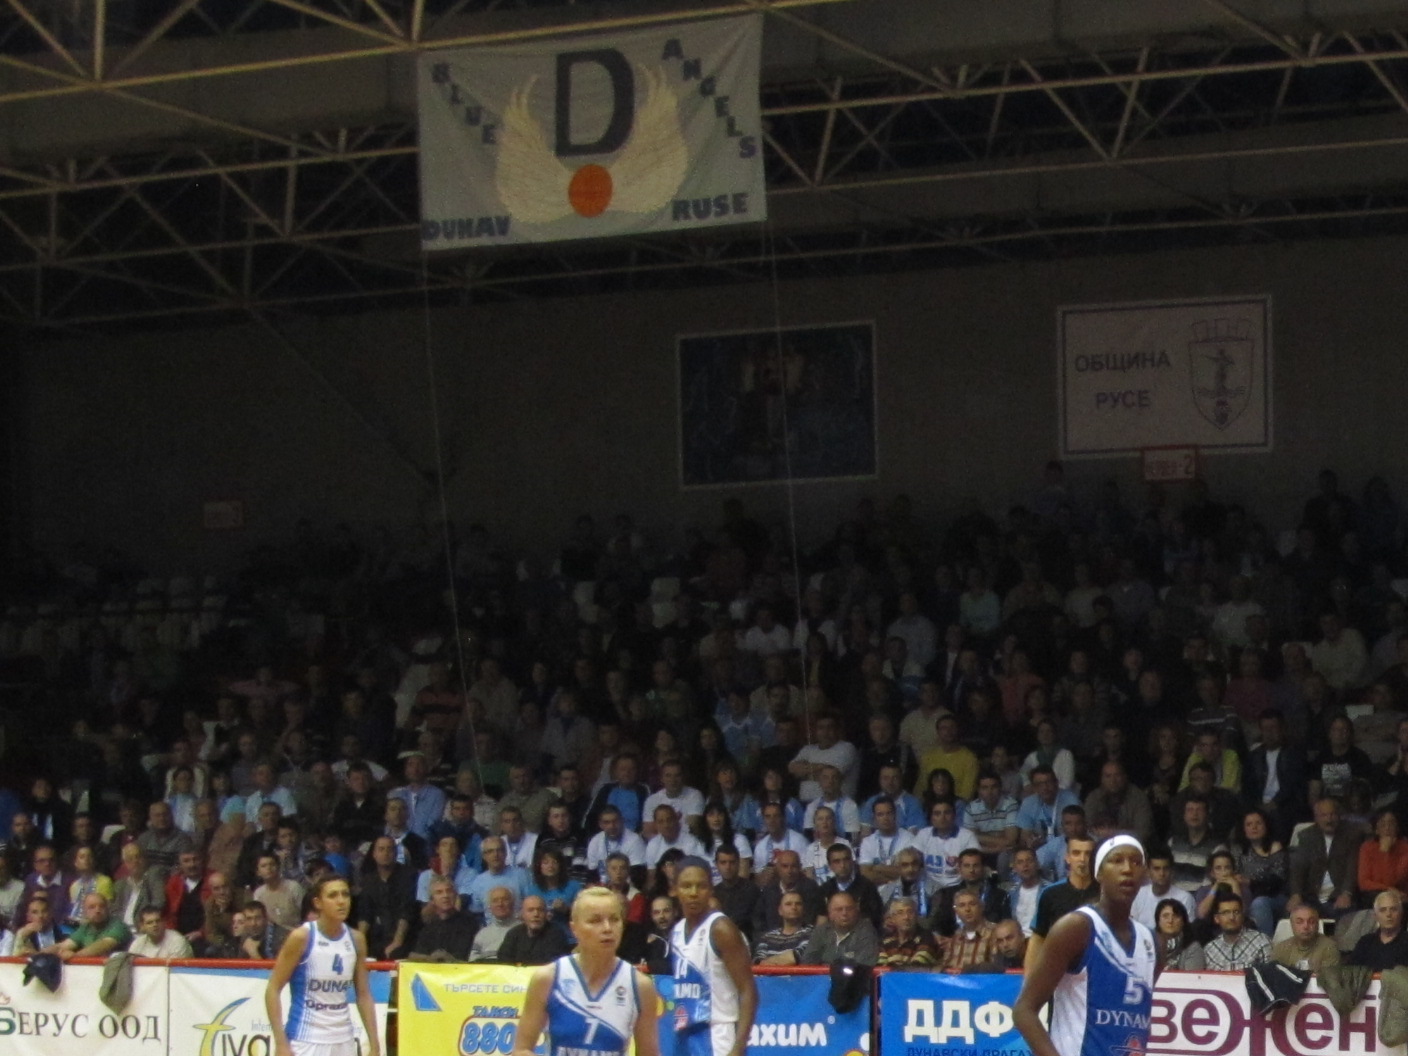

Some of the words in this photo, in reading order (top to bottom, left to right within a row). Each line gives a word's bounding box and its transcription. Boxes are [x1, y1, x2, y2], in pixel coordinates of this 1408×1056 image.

[556, 47, 635, 157] D
[662, 38, 757, 158] ANGELS
[672, 193, 750, 221] RUSE
[421, 215, 512, 241] DUNAV
[1074, 351, 1171, 373] ОБЩИНА
[1096, 390, 1150, 409] РУСЕ
[331, 954, 344, 975] 4
[444, 983, 499, 993] ТЪРСЕТЕ
[503, 985, 528, 994] СИН
[1123, 976, 1144, 1005] 5
[98, 1015, 161, 1044] ООД
[584, 1017, 600, 1044] 7
